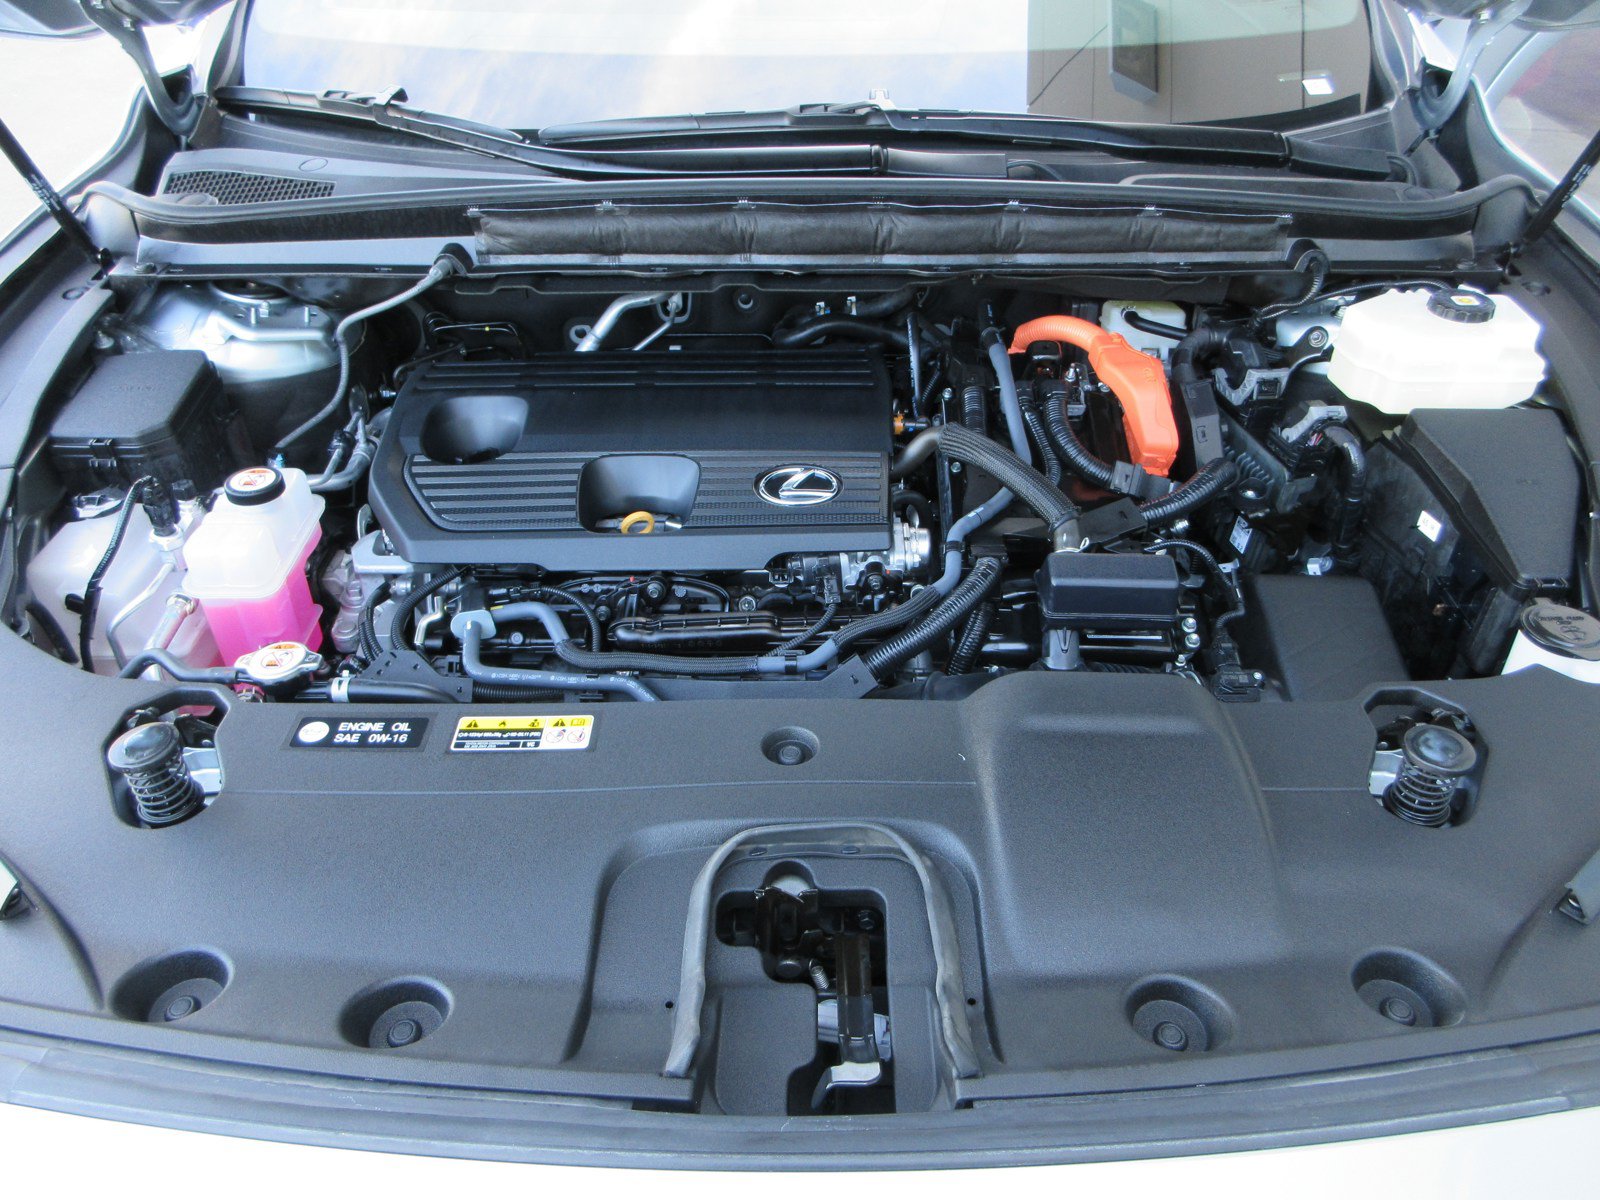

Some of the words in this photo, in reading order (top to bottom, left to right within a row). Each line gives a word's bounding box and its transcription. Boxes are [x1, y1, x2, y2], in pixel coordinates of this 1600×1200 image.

[338, 722, 385, 731] ENGINE
[391, 722, 412, 731] OIL
[334, 733, 361, 742] SAE
[368, 733, 408, 743] 0W-16
